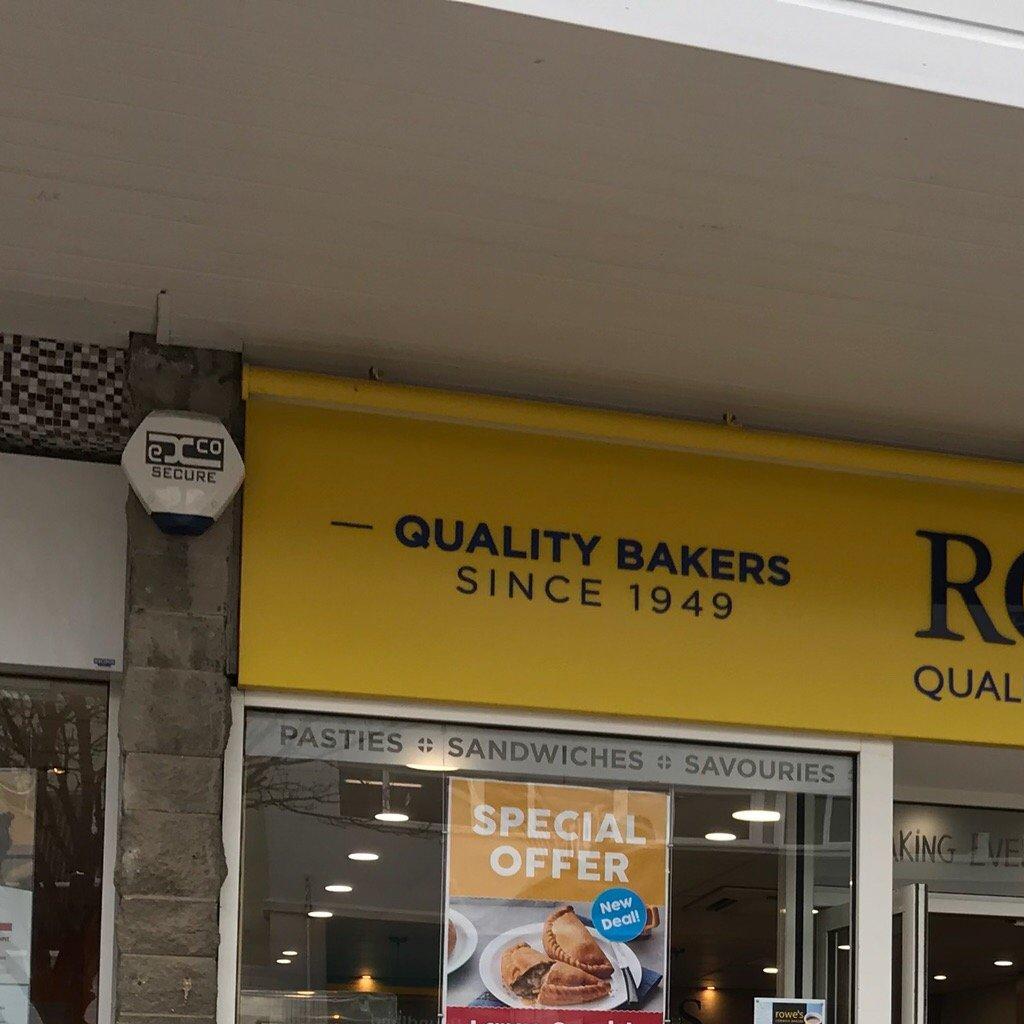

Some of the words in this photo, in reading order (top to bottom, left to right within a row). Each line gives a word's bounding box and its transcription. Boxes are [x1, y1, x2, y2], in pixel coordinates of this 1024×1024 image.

[151, 466, 217, 483] SECURE
[395, 514, 601, 566] QUALITY
[617, 538, 792, 587] BAKERS
[456, 565, 602, 606] SINCE
[630, 583, 733, 619] 1949
[280, 725, 403, 753] PASTIES
[447, 737, 644, 771] SANDWICHES
[684, 753, 835, 783] SAVOURIES
[472, 804, 647, 845] SPECIAL
[490, 845, 629, 883] OFFER
[600, 897, 632, 914] New
[601, 911, 640, 931] Deal!
[775, 1009, 804, 1019] rowe's
